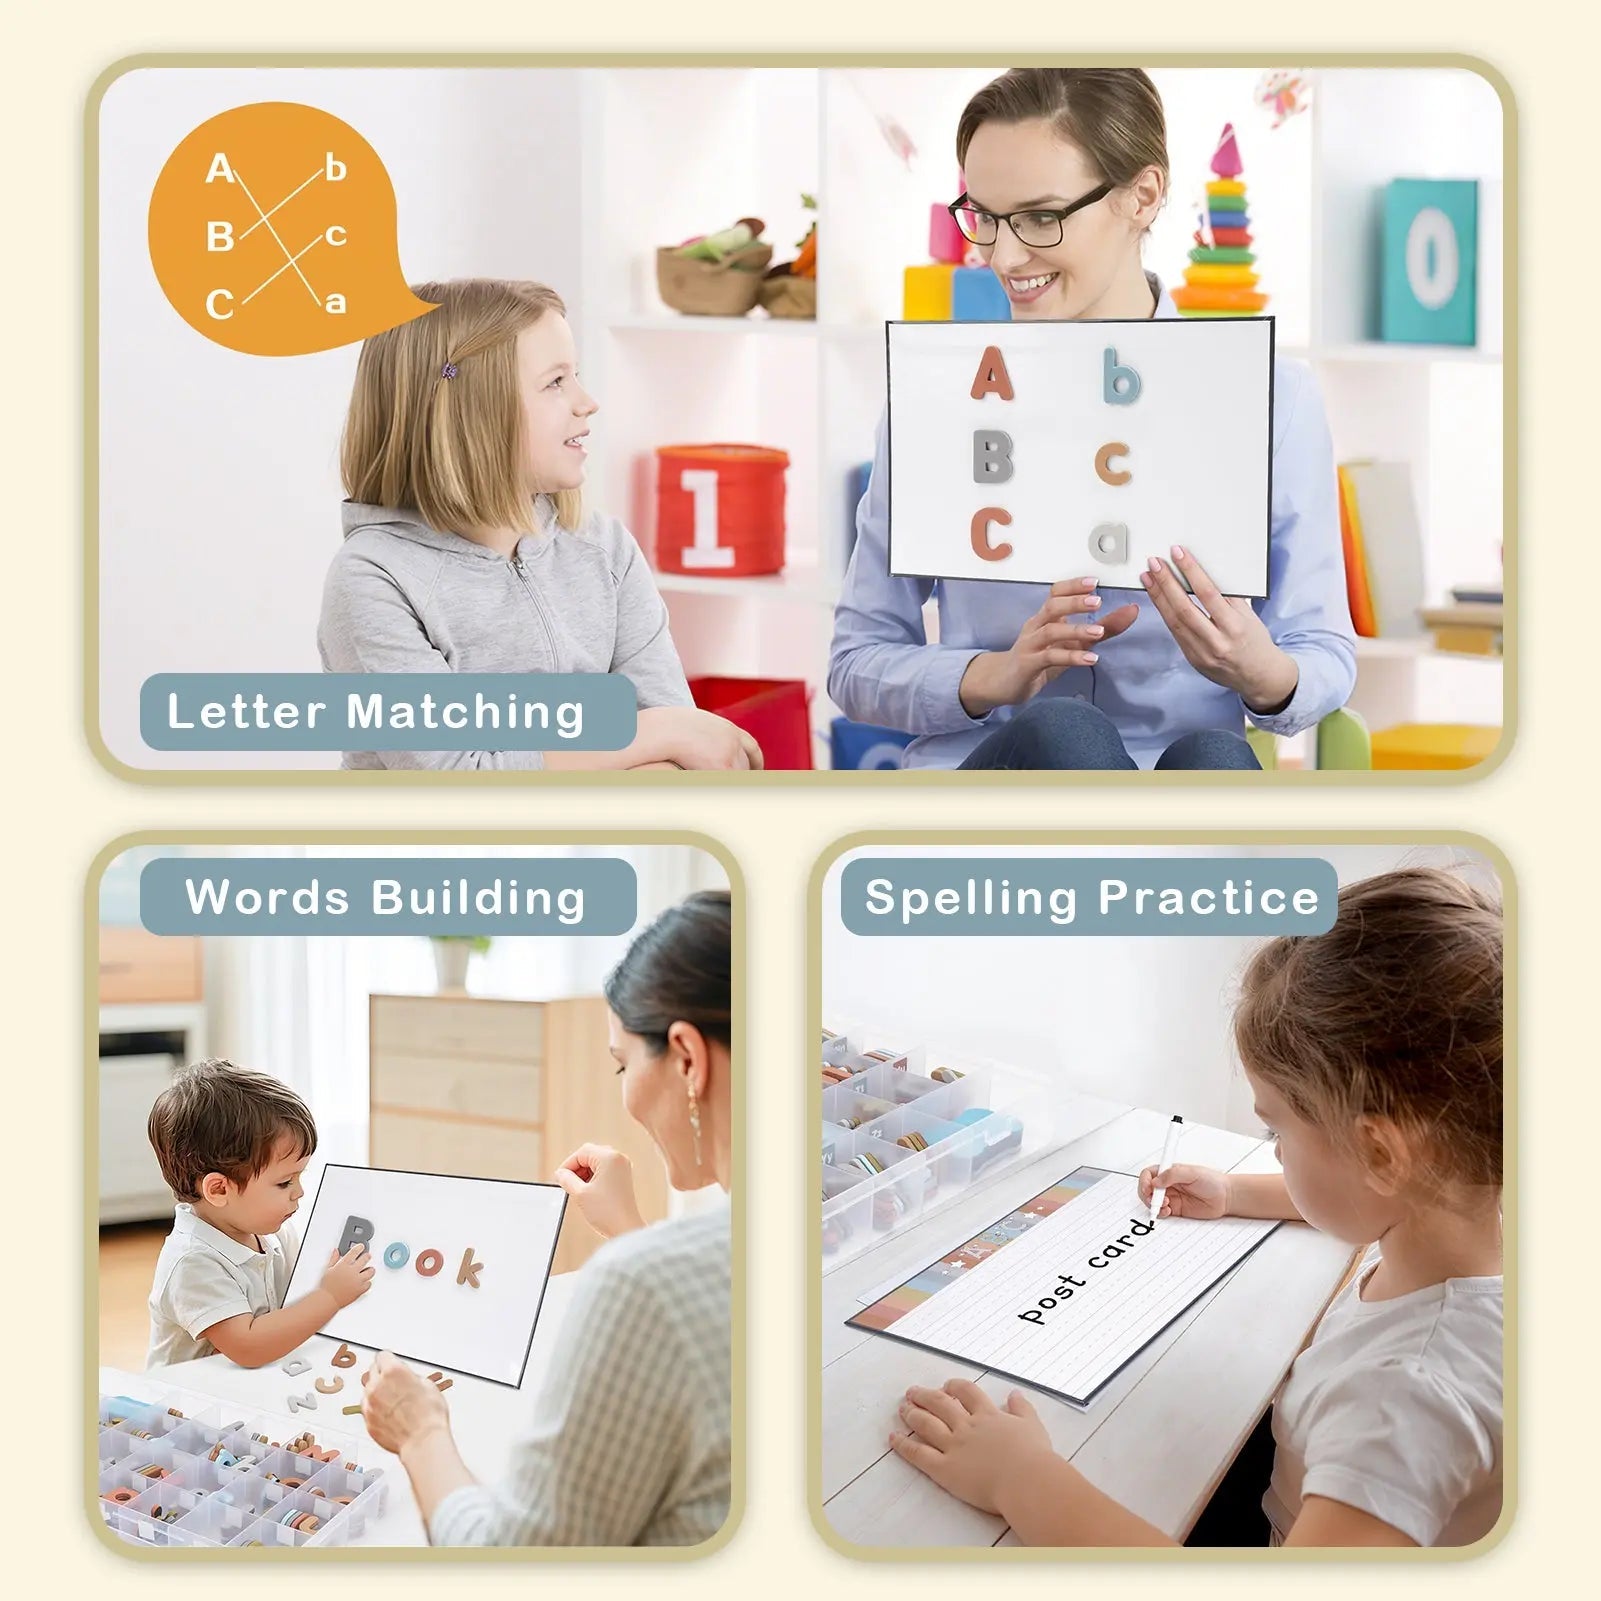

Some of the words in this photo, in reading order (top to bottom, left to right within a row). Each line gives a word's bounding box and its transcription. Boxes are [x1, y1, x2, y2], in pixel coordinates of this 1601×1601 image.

[970, 345, 1014, 401] A
[1103, 346, 1142, 405] b
[973, 429, 1014, 484] B
[1094, 442, 1132, 486] c
[681, 470, 735, 569] 1
[970, 506, 1013, 562] C
[1088, 521, 1128, 564] a
[338, 1215, 485, 1289] Book
[1017, 1275, 1086, 1326] post
[1088, 1218, 1155, 1268] card
